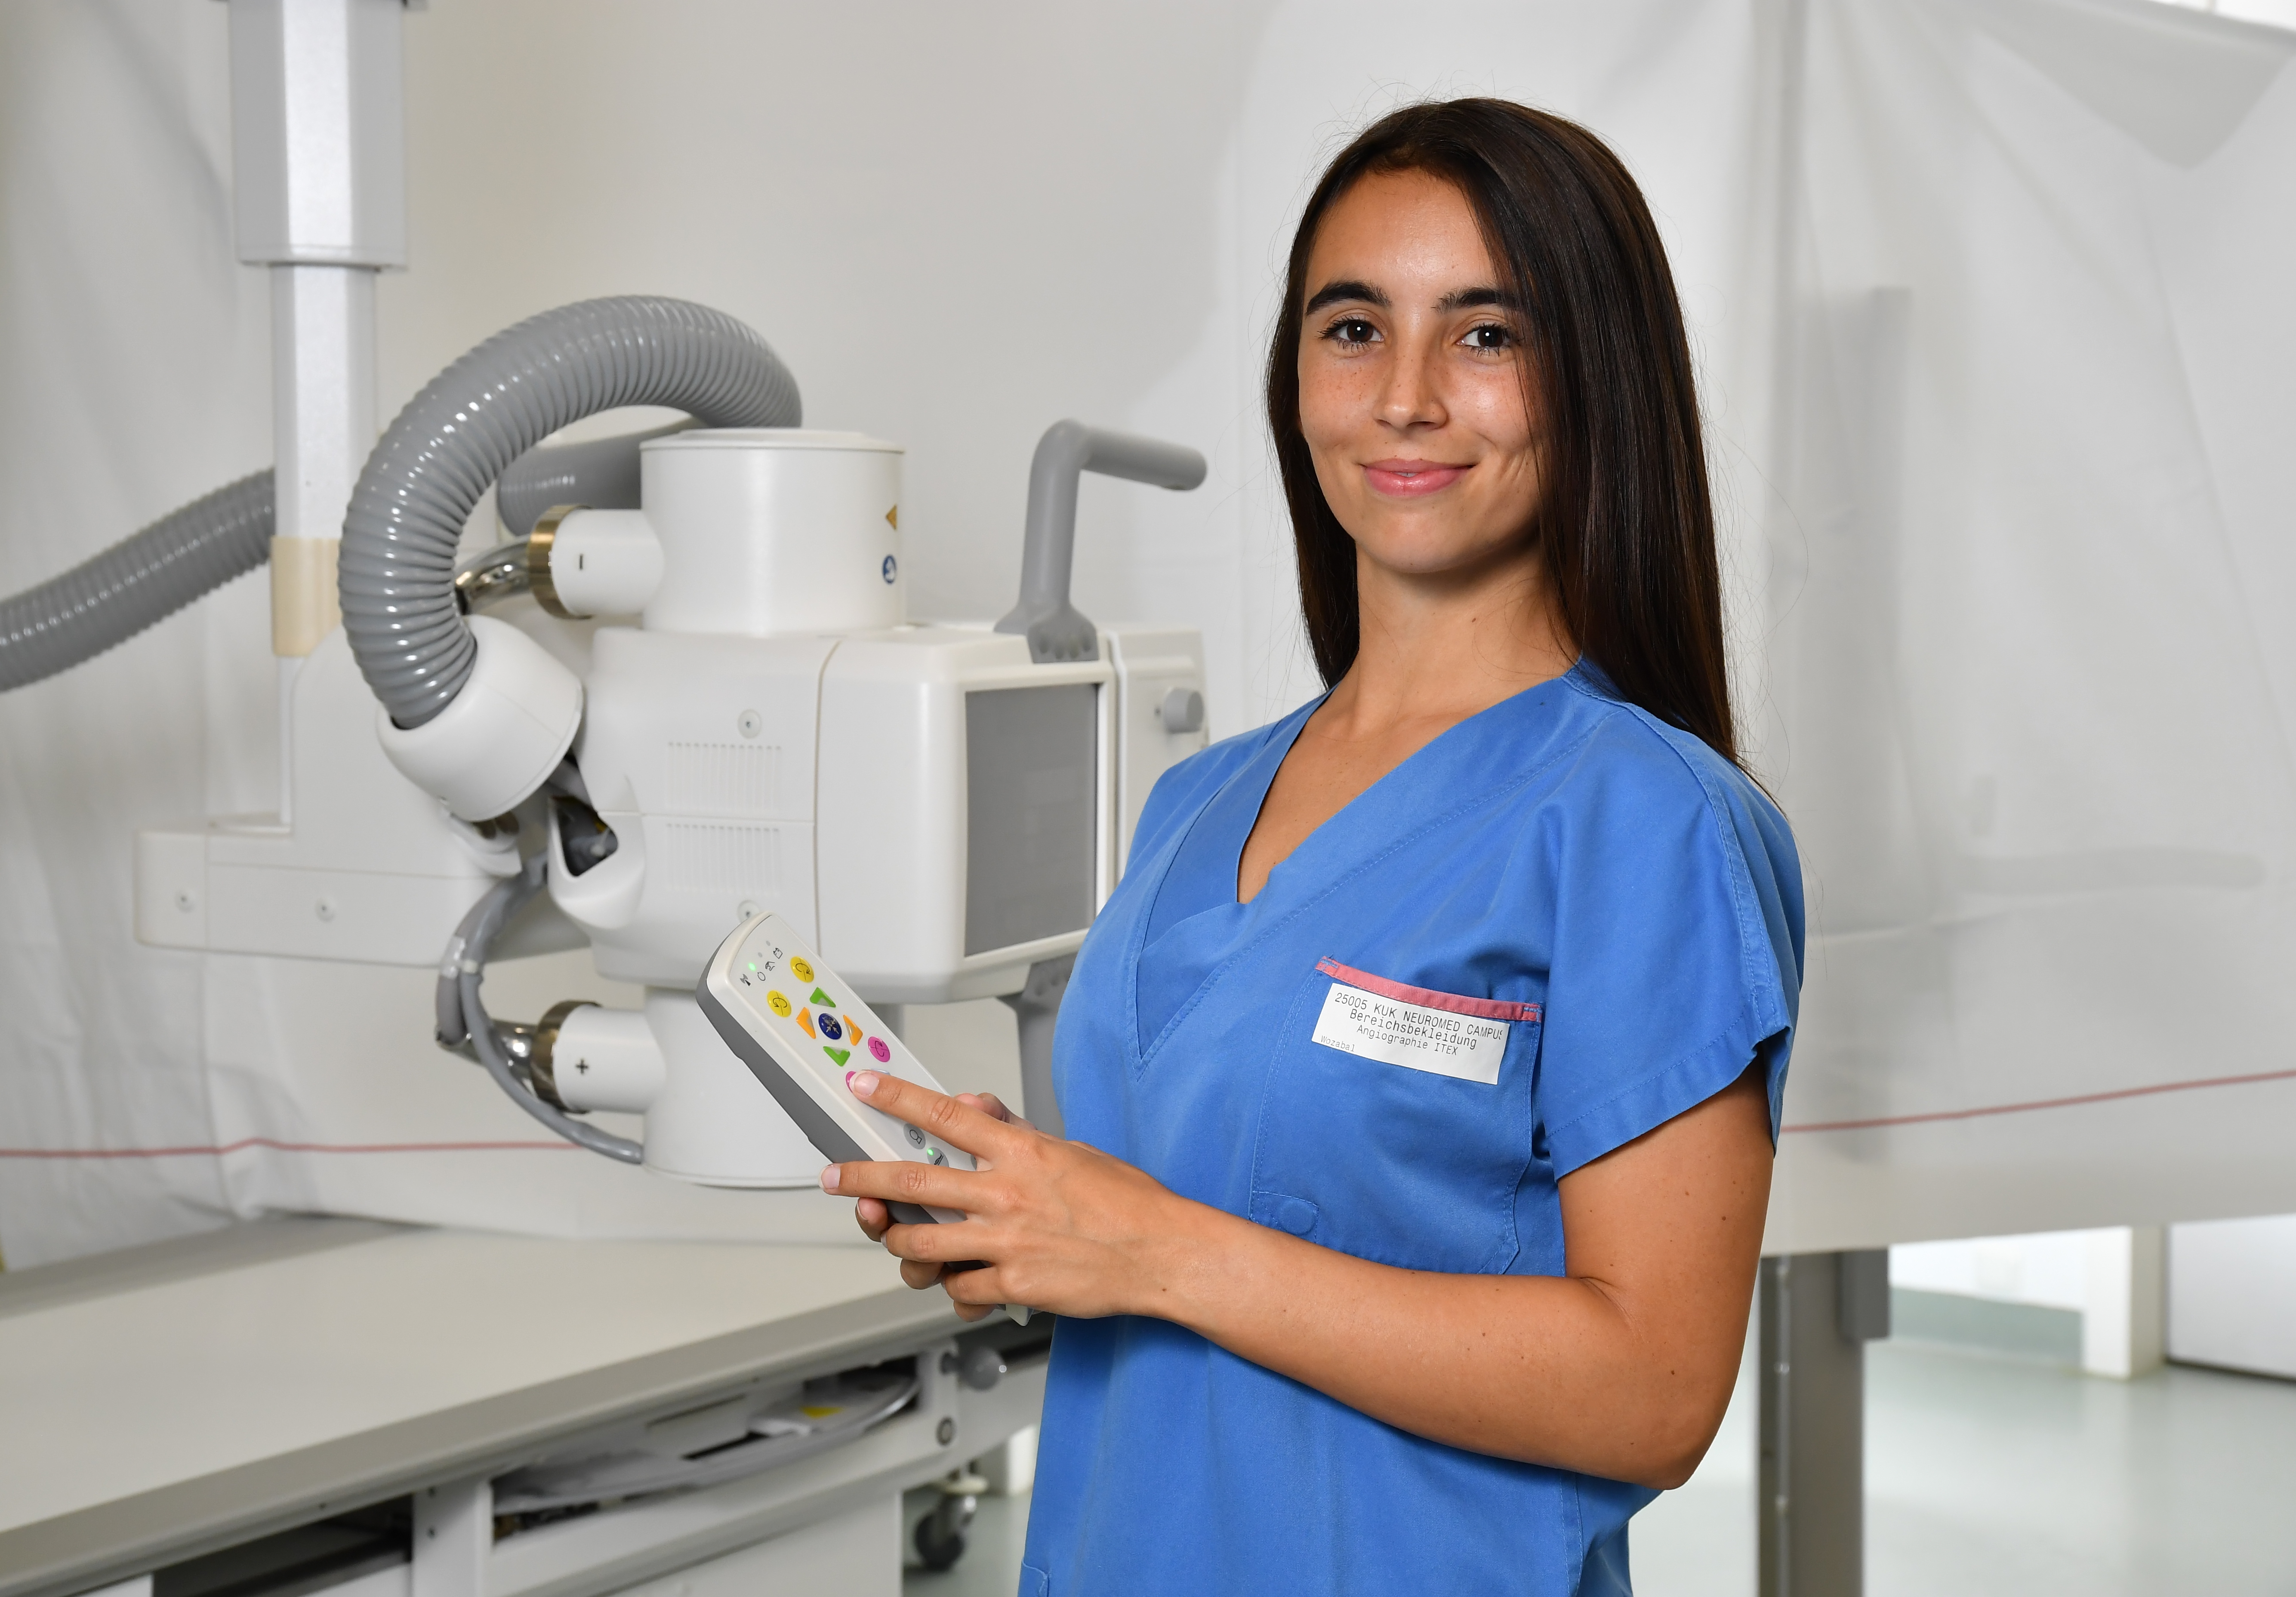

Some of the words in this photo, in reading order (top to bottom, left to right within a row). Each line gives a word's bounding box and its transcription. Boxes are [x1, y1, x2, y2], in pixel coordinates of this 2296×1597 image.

[1334, 992, 1368, 1010] 25005
[1374, 1003, 1397, 1019] KUK
[1403, 1011, 1460, 1032] NEUROMED
[1350, 1008, 1477, 1050] Bereichsbekleidung
[1320, 1035, 1355, 1052] Wozabal
[1356, 1024, 1428, 1049] Angiographie
[1434, 1042, 1458, 1056] ITEX
